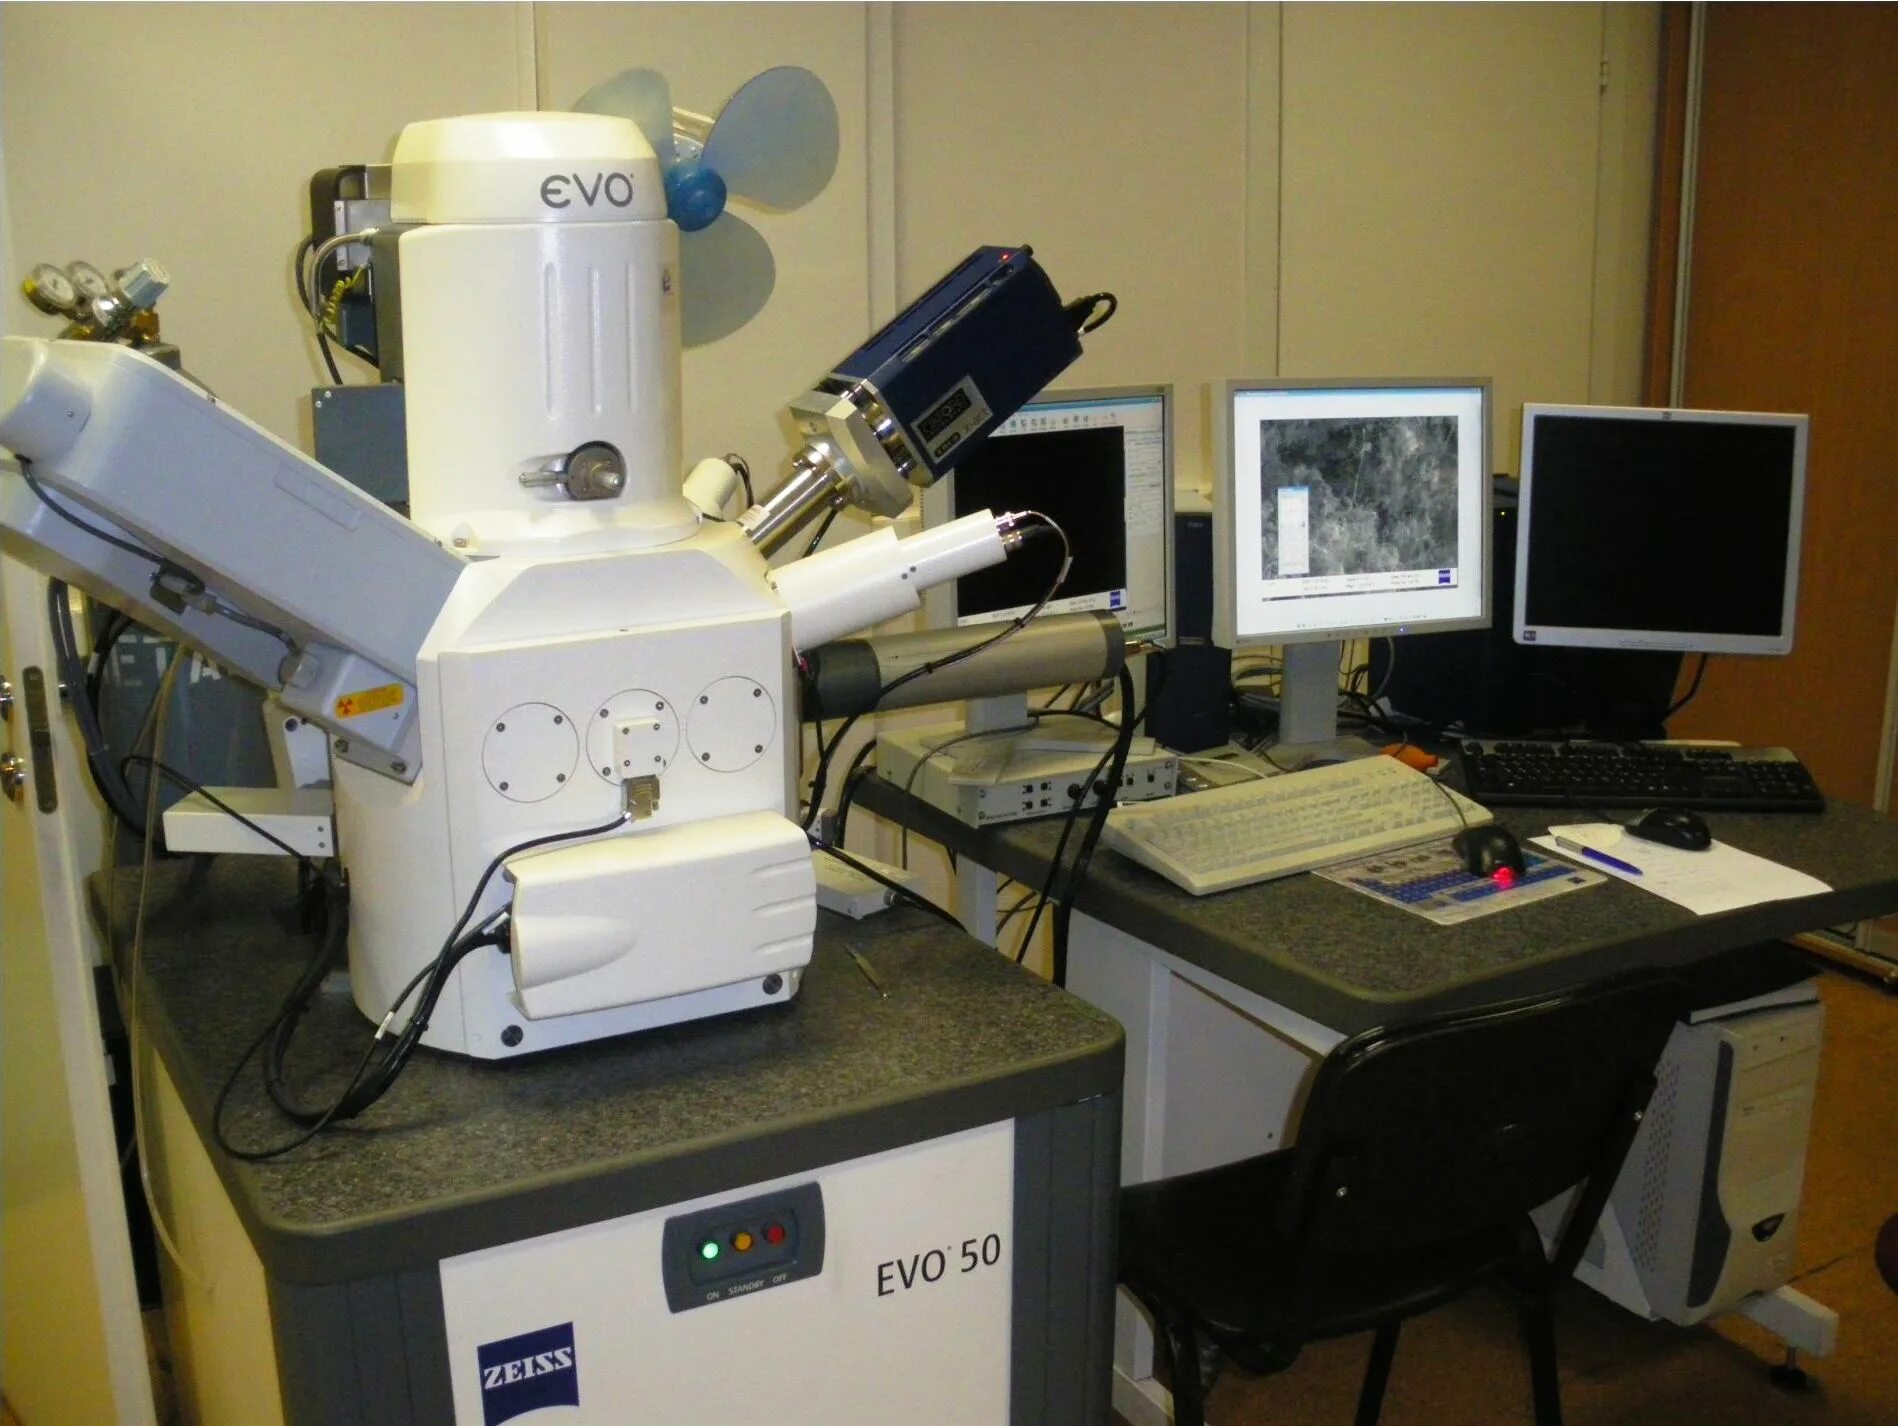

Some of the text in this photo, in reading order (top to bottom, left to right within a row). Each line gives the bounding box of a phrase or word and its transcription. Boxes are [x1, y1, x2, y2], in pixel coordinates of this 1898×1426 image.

[540, 172, 634, 209] EVO
[877, 1233, 1001, 1297] EVO 50
[706, 1273, 788, 1301] ON STANDBY OFF
[483, 1346, 573, 1390] ZEISS
